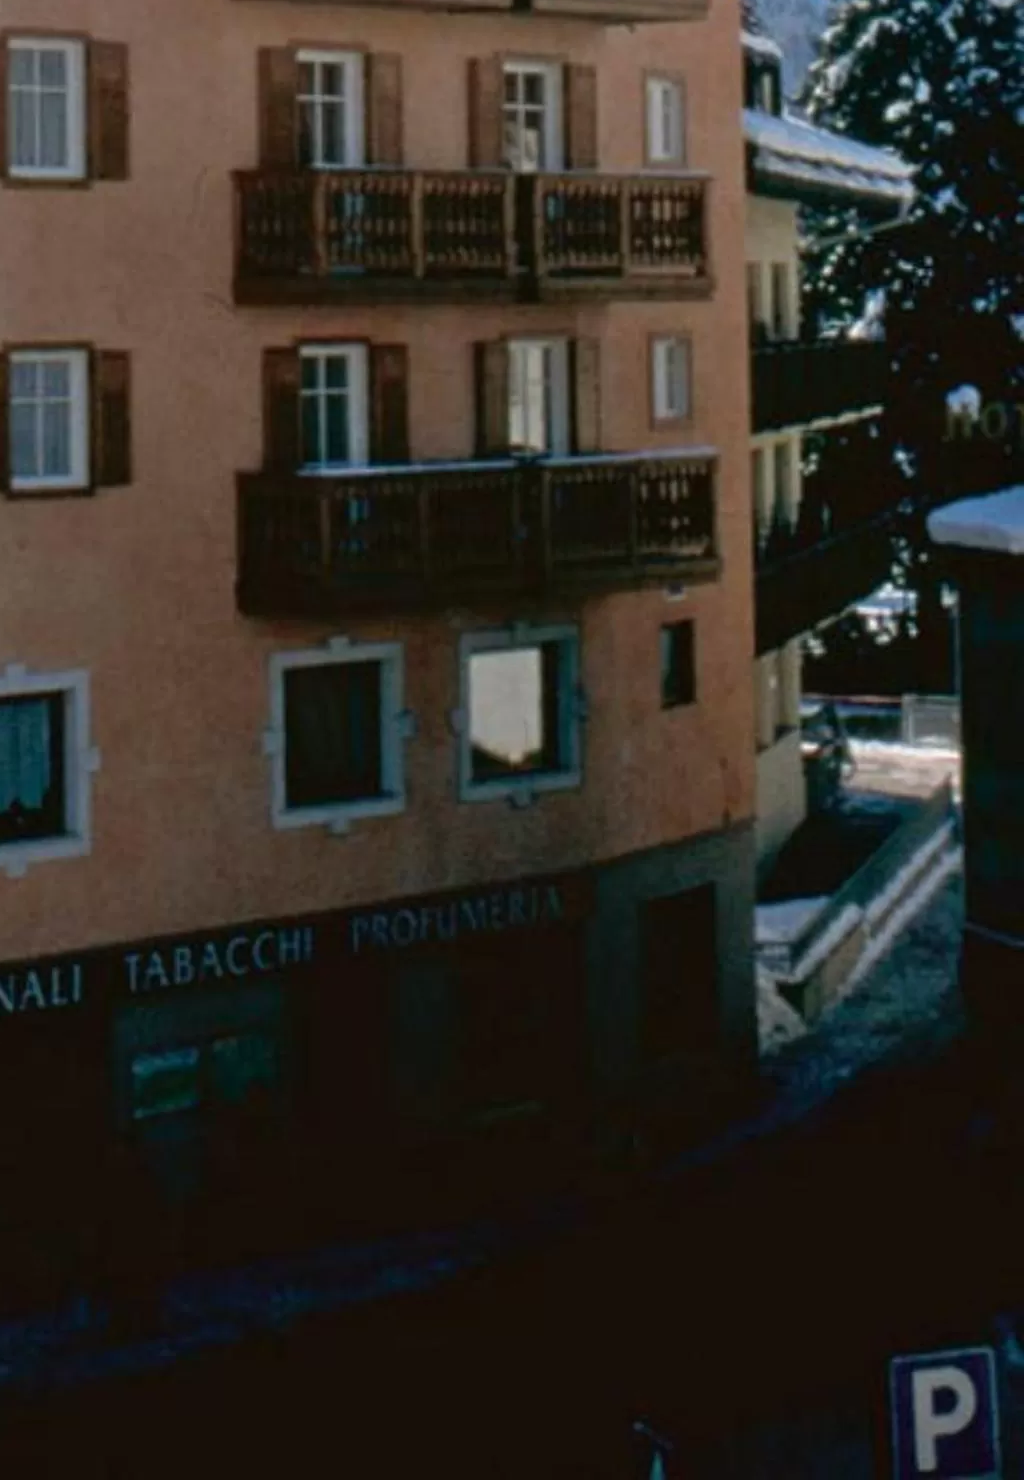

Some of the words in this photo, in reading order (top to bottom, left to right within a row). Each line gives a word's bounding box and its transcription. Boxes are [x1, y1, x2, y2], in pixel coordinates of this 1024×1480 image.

[123, 926, 313, 994] TABACCHI
[350, 883, 562, 953] PROFUMERIA
[910, 1364, 979, 1473] P
